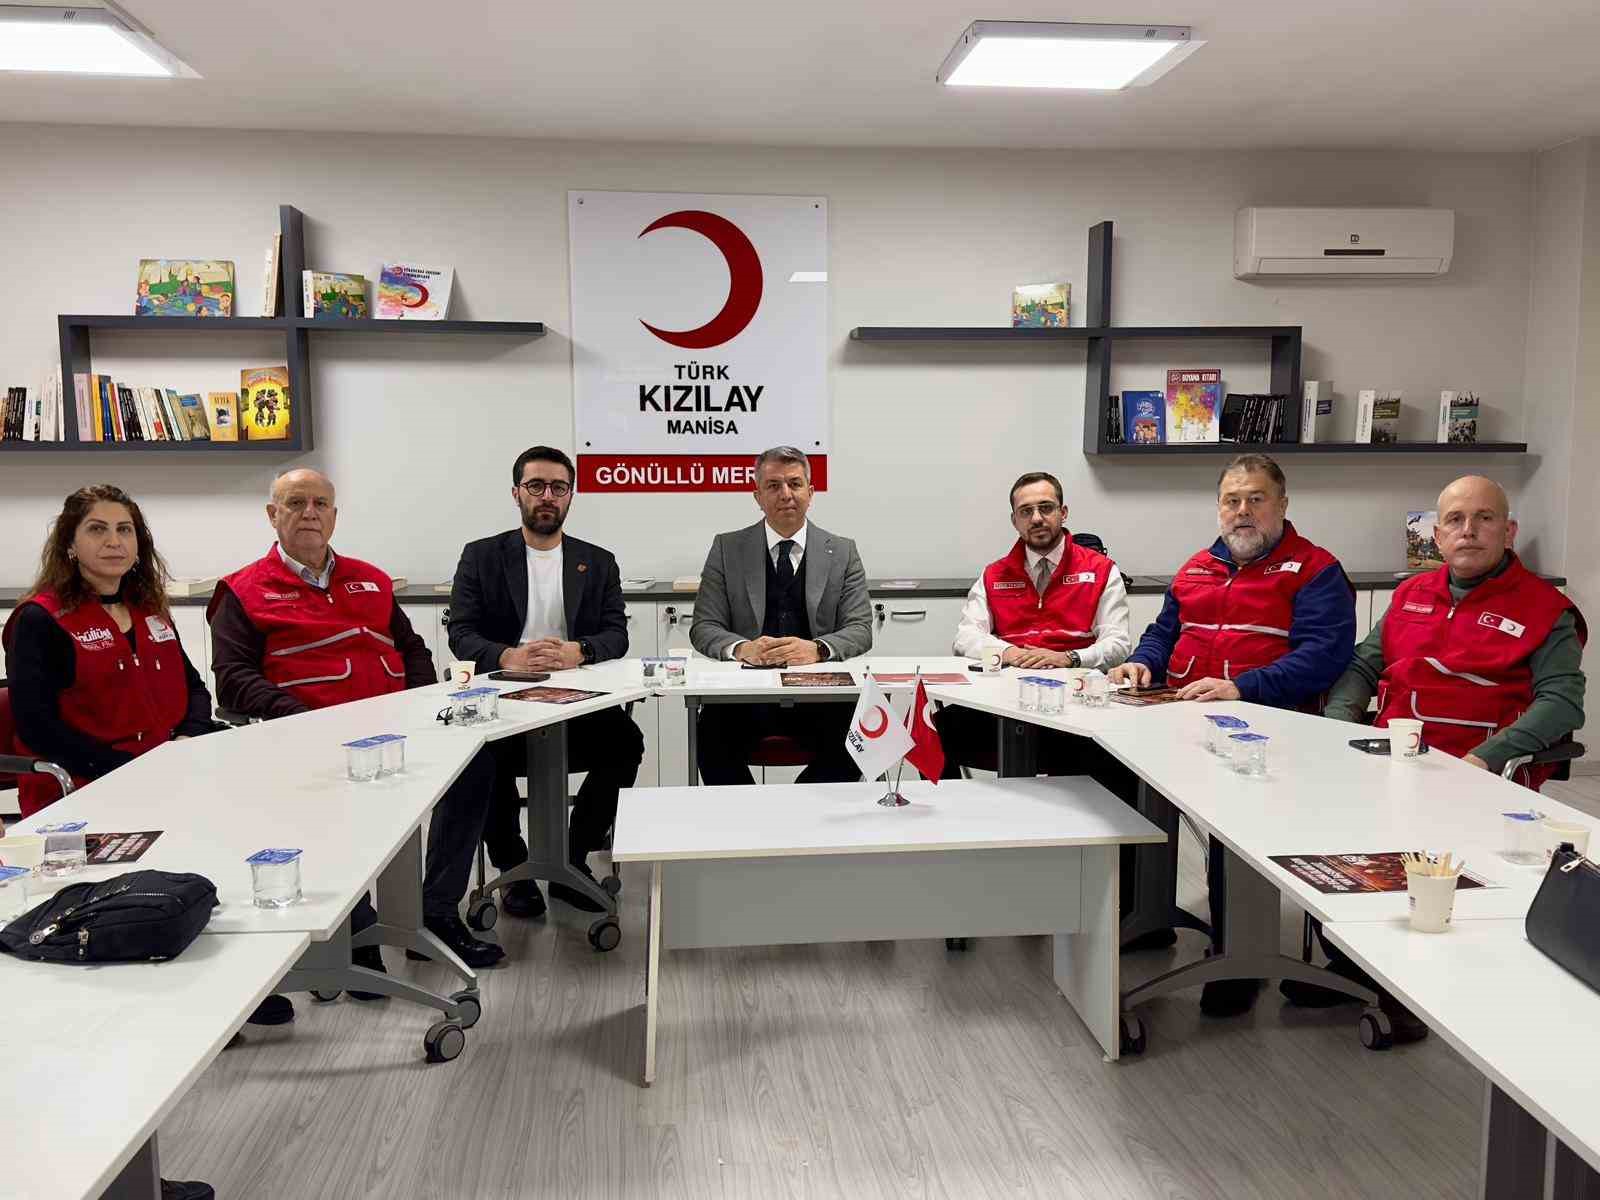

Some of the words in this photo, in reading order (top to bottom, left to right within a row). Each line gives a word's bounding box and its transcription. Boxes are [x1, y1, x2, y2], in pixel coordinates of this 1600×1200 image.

[674, 361, 730, 380] TÜRK
[639, 385, 764, 412] KIZILAY
[667, 416, 739, 434] MANİSA
[595, 463, 705, 485] GÖNÜLLÜ
[712, 466, 756, 484] MER
